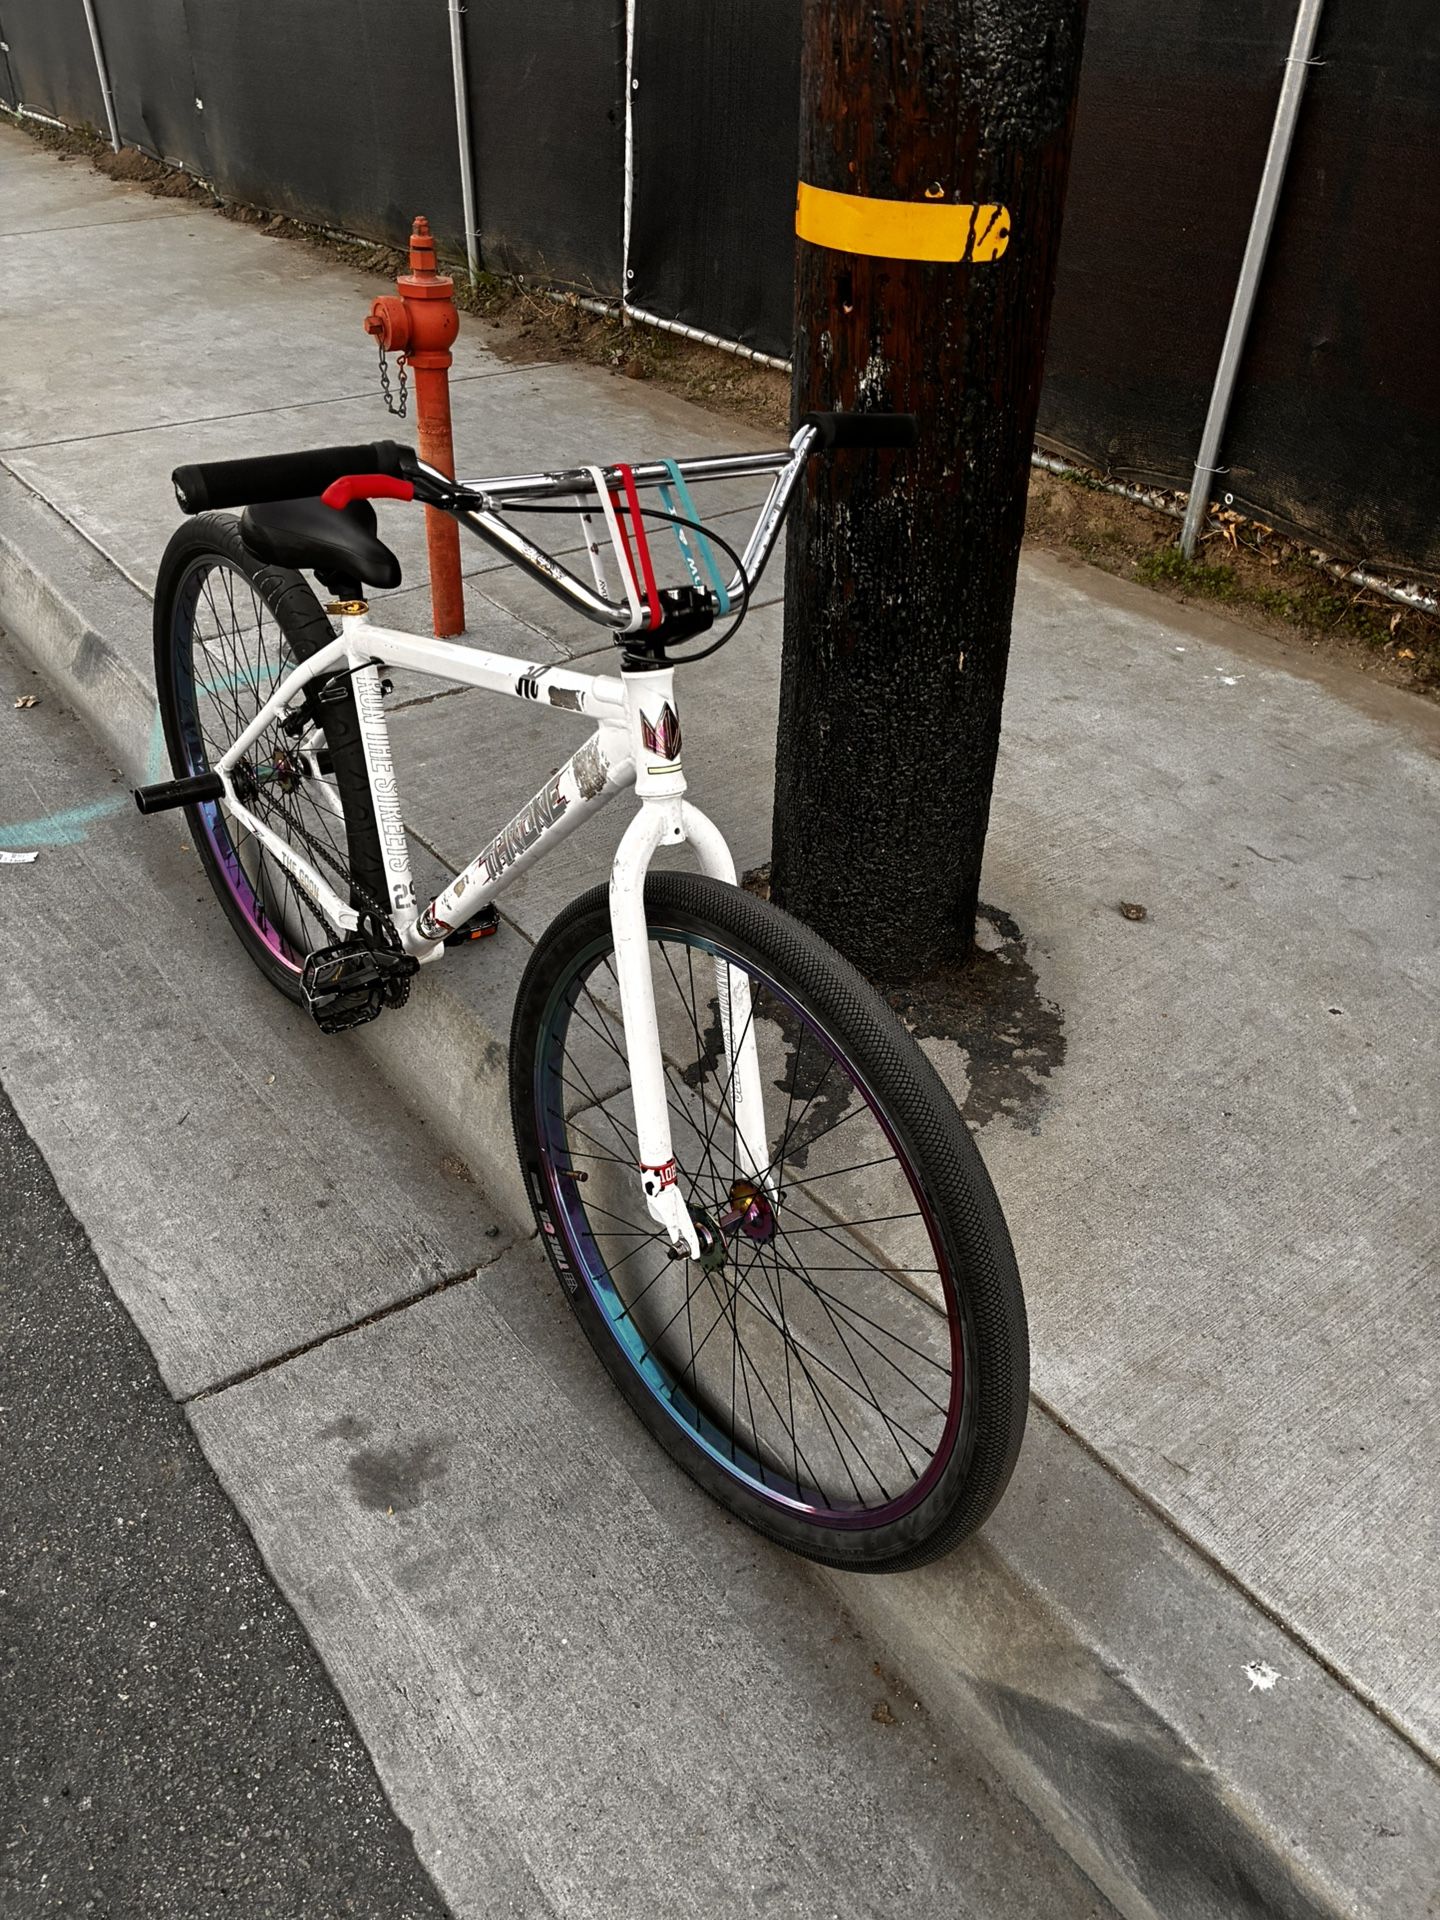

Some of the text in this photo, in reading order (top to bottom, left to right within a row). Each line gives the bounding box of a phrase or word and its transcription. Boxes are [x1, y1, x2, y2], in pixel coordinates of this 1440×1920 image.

[356, 677, 411, 873] RUN THE STREETS
[282, 851, 297, 876] THE
[480, 773, 569, 882] THRONE
[547, 1234, 569, 1270] TIRE
